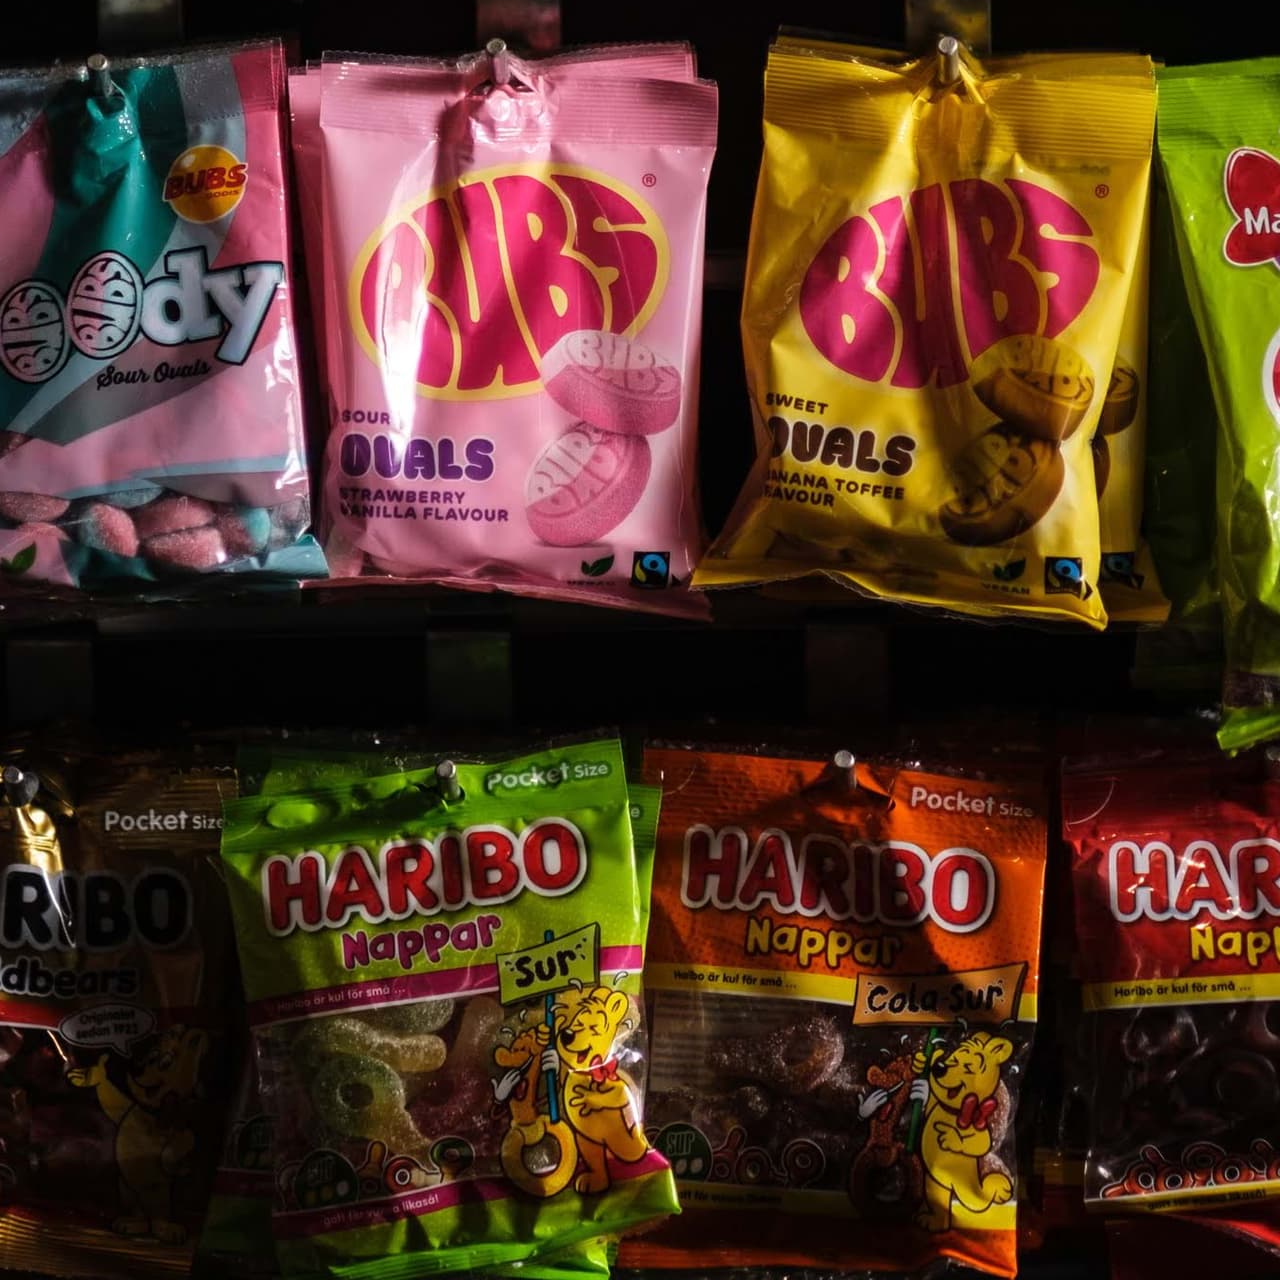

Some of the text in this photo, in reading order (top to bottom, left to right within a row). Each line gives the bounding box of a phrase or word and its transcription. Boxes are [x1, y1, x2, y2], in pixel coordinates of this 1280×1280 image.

[165, 161, 249, 203] BUBS
[360, 173, 660, 391] BUBS
[799, 178, 1100, 389] BUBS
[97, 359, 211, 391] Sour Ovals
[341, 410, 392, 425] SOUR
[765, 392, 829, 415] SWEET
[339, 432, 496, 482] OVALS
[339, 488, 467, 505] STRAWBERRY
[834, 477, 906, 501] TOFFEE
[339, 503, 510, 523] VANILLA FLAVOUR
[487, 761, 610, 791] Pocket Size
[911, 786, 1035, 818] Pocket Size
[104, 808, 188, 832] Pocket
[264, 818, 586, 935] HARIBO
[683, 826, 993, 931] HARIBO
[341, 915, 502, 971] Nappar
[746, 916, 903, 969] Nappar
[514, 946, 577, 988] Sur
[1114, 977, 1238, 1000] Haribo kul för små
